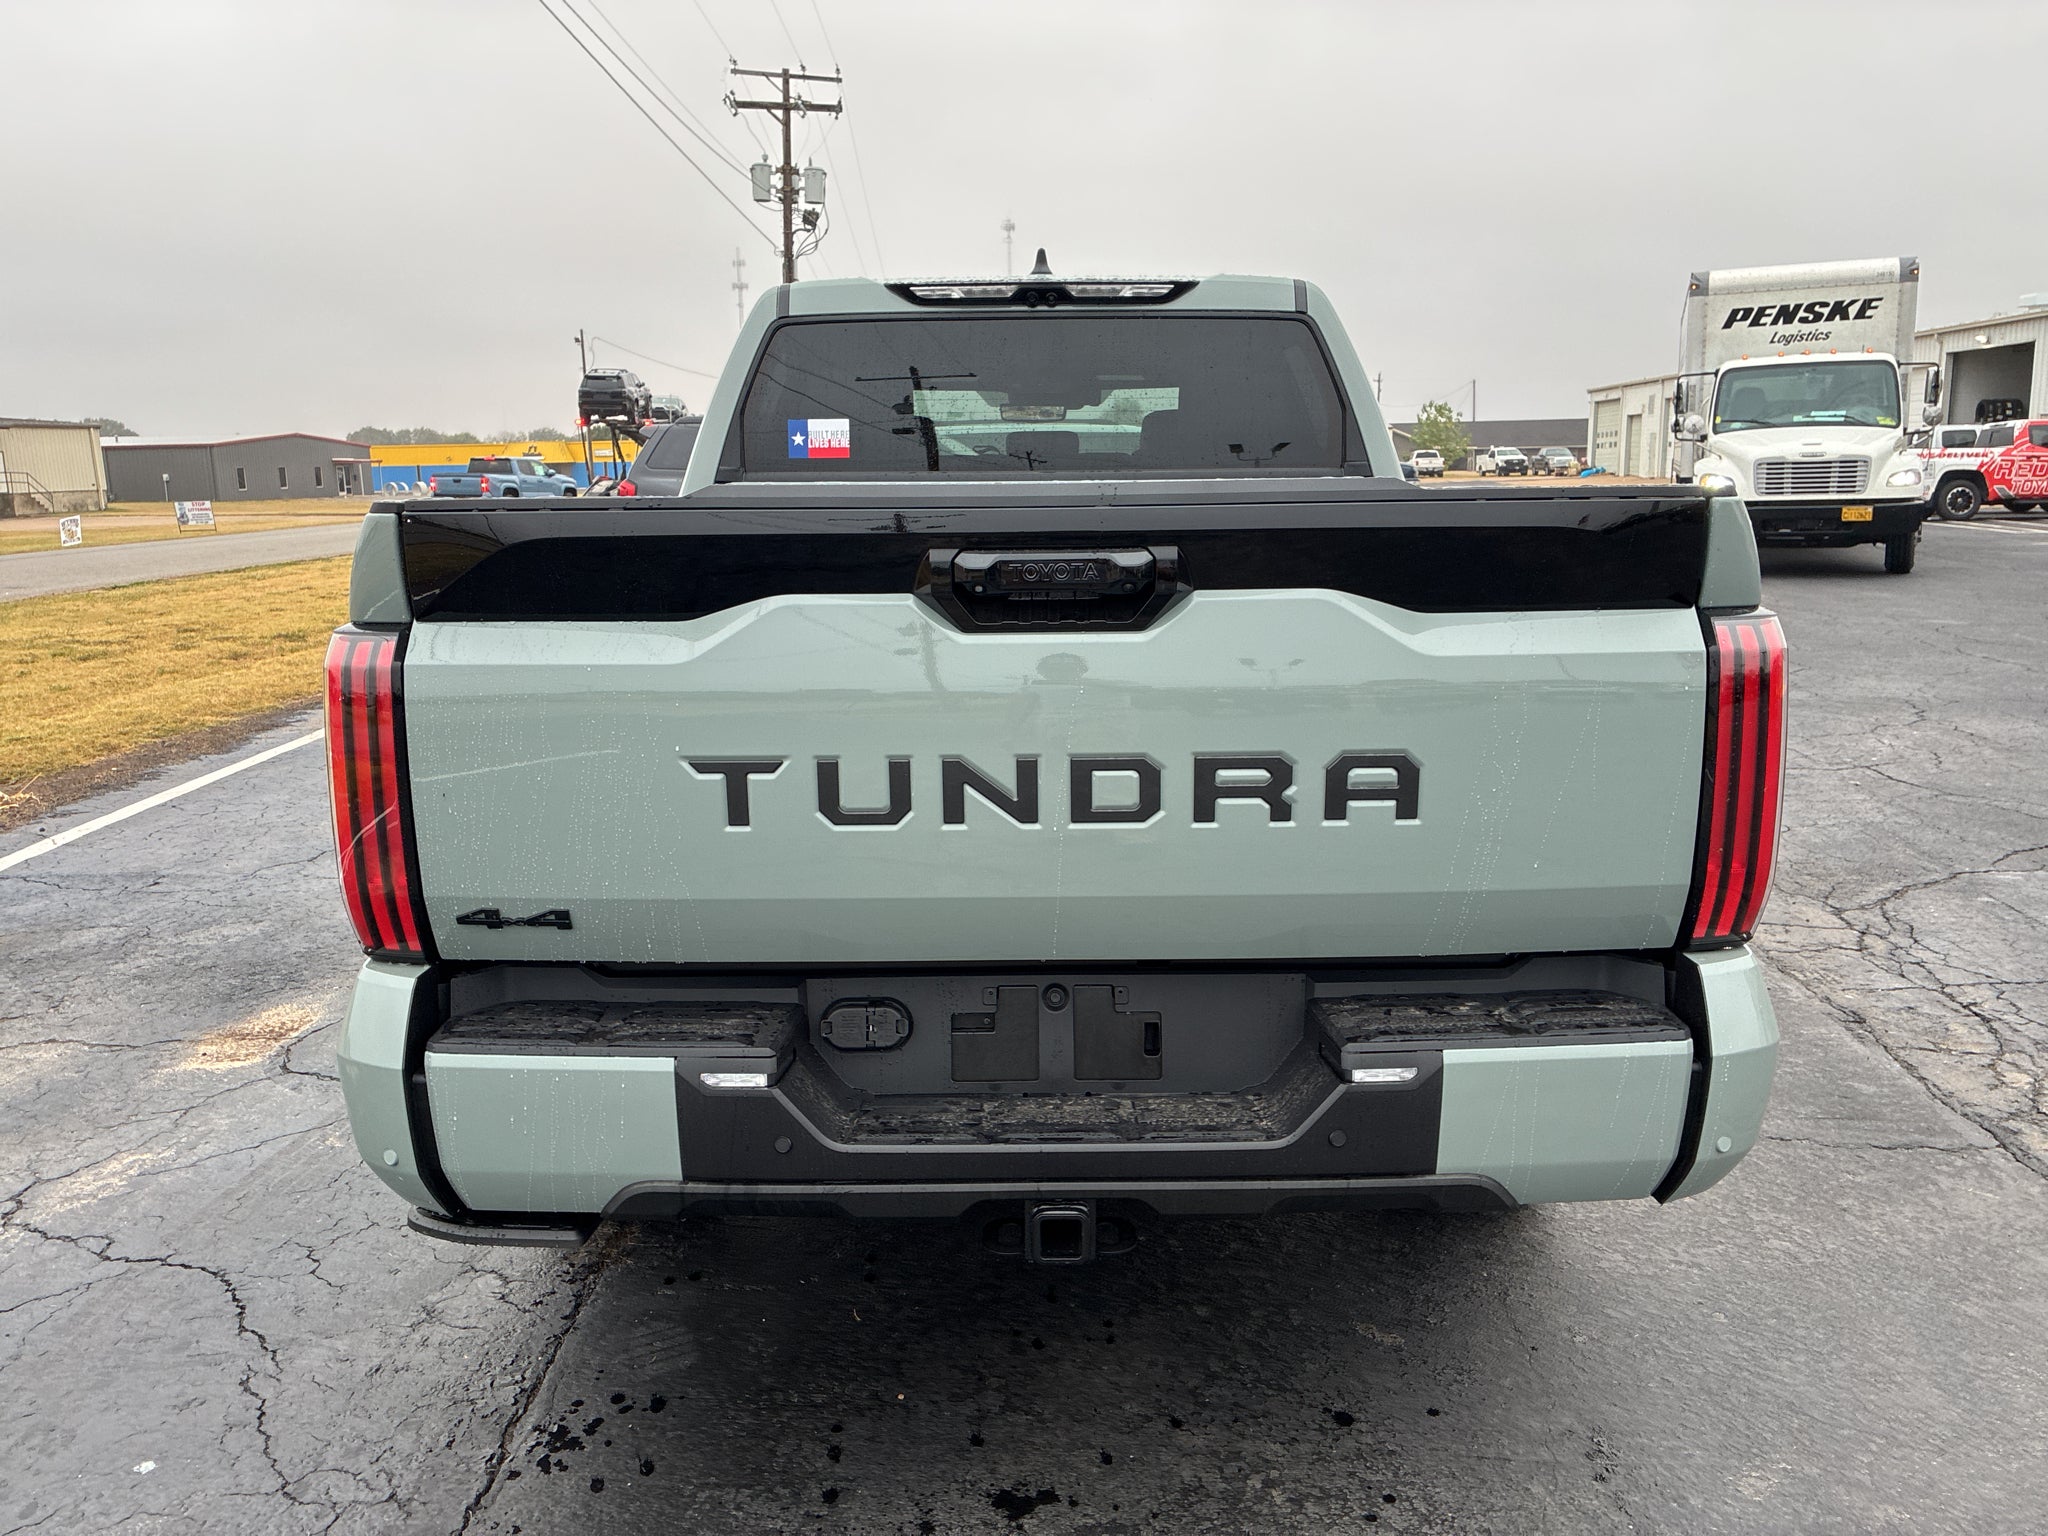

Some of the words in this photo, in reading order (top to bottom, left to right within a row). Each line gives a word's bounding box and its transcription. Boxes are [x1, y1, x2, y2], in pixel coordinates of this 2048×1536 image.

[1721, 297, 1884, 330] PENSKE
[1769, 328, 1832, 346] Logistics
[808, 430, 829, 439] BUILT
[831, 430, 850, 439] HERE
[808, 438, 829, 448] LIVES
[831, 438, 850, 448] HERE
[1938, 450, 1989, 459] DELIVER
[1994, 456, 2048, 480] RED
[1008, 562, 1099, 581] TOYOTA
[682, 749, 1423, 831] TUNDRA
